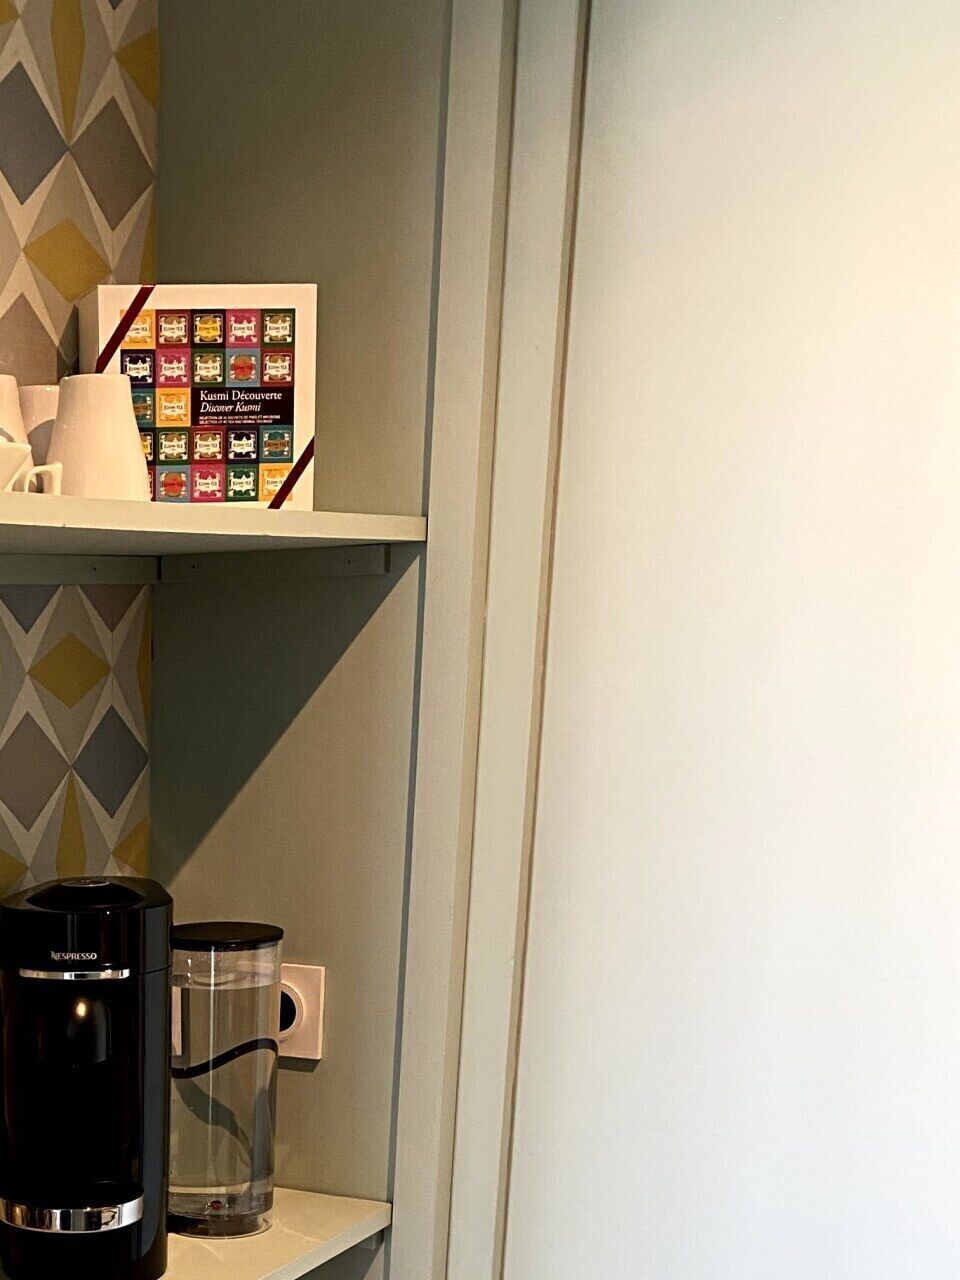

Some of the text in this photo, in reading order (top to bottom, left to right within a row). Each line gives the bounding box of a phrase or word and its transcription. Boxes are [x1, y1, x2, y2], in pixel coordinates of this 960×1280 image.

[200, 390, 282, 401] Kusmi Découverte
[200, 401, 262, 413] Discover Kusmi
[50, 950, 98, 961] NESPRESSO
